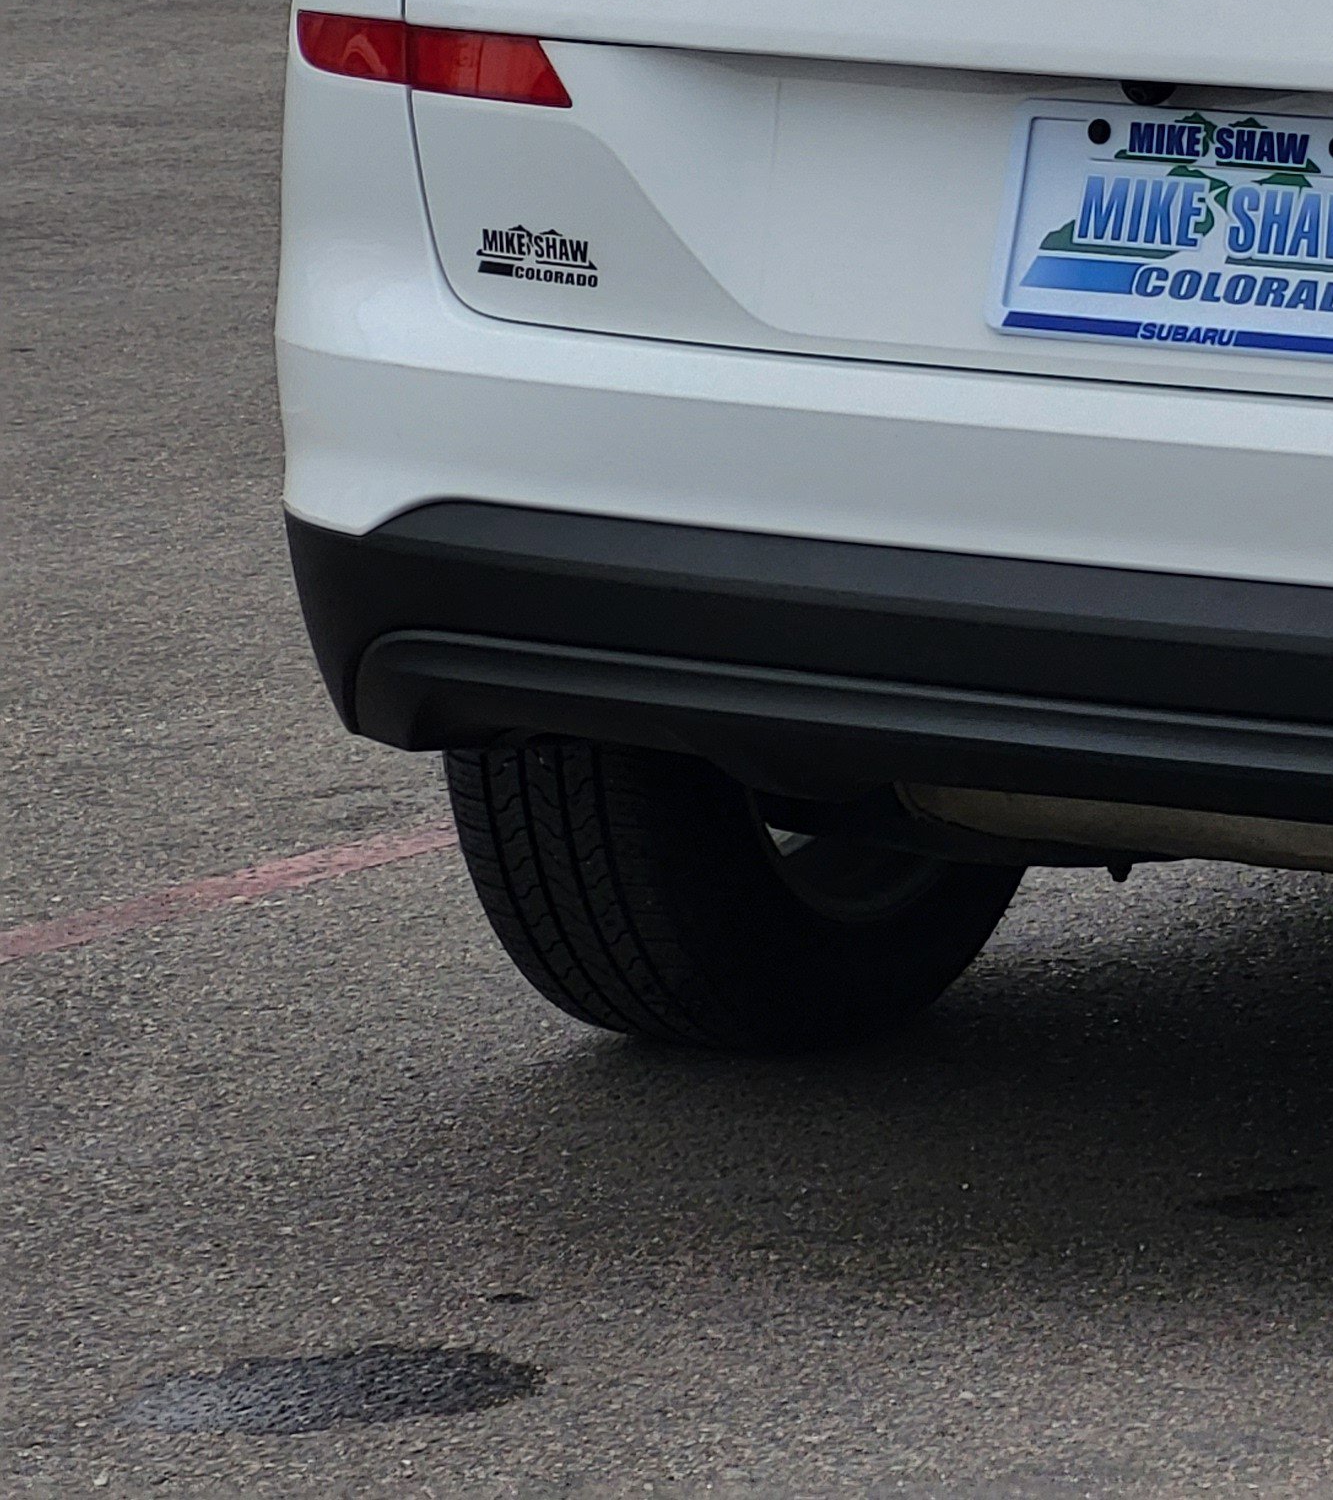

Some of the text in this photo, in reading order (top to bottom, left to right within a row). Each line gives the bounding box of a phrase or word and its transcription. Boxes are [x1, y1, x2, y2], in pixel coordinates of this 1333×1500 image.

[1127, 122, 1310, 165] MIKE SHAW
[1077, 176, 1206, 246] MIKE
[482, 228, 588, 263] MIKE SHAW
[514, 265, 599, 288] COLORADO
[1138, 323, 1236, 347] SUBARU
